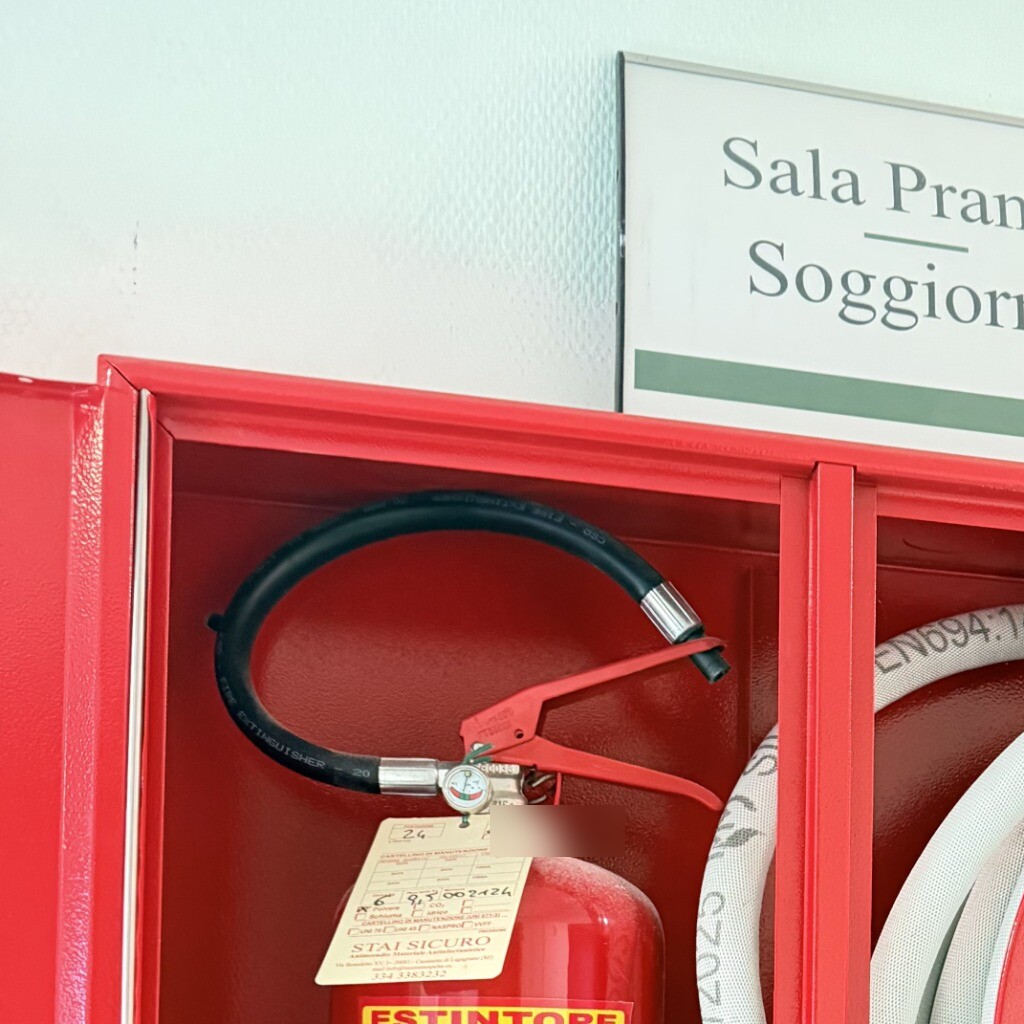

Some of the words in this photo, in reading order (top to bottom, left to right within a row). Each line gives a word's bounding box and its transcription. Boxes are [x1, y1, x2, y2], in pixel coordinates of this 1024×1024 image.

[723, 136, 866, 207] Sala
[236, 709, 326, 771] EXTINGUISHER
[352, 767, 371, 779] 20
[351, 941, 401, 953] STAI
[406, 935, 492, 951] SICURO
